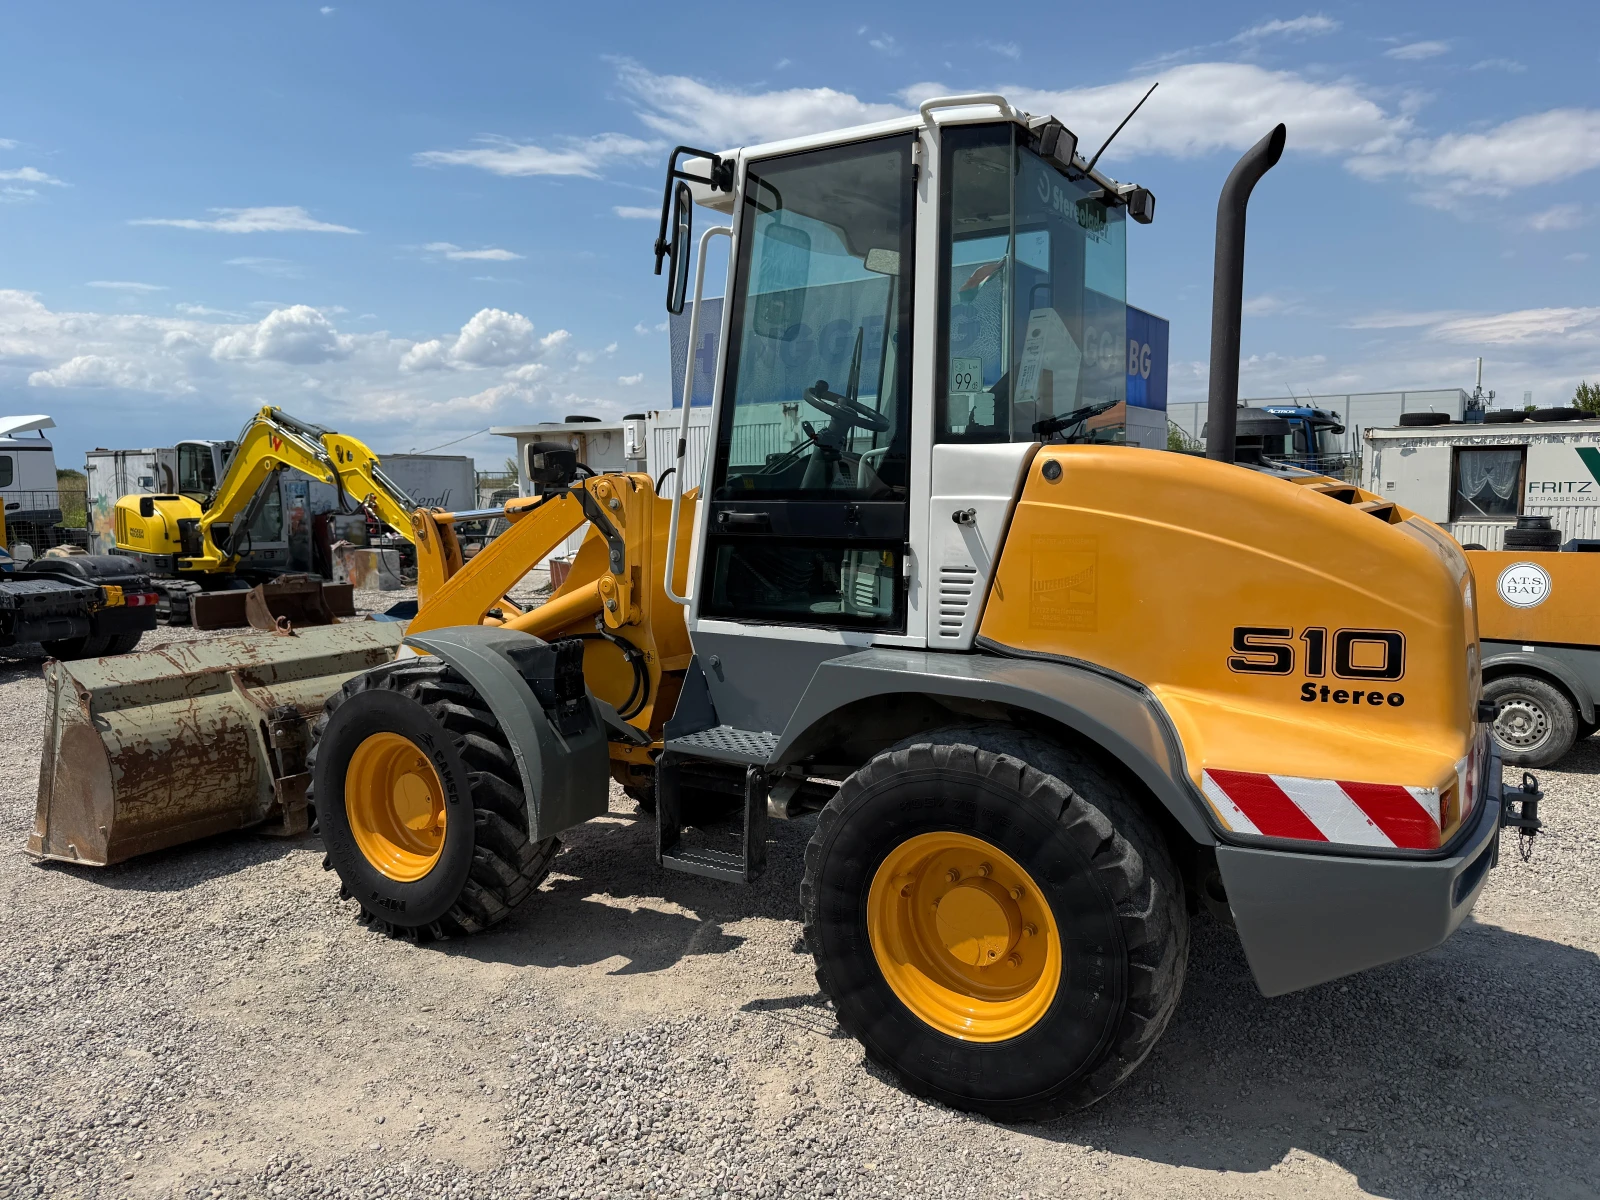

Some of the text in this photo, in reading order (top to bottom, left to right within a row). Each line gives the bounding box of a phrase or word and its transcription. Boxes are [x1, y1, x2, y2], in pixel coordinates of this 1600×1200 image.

[955, 372, 972, 390] 99
[1528, 481, 1593, 493] FRITZ
[1507, 576, 1544, 585] A.T.S.
[1507, 585, 1542, 595] BAU
[1227, 626, 1407, 682] 510
[1300, 682, 1405, 707] Stereo
[434, 749, 460, 805] CAMSO
[368, 890, 407, 912] MPT
